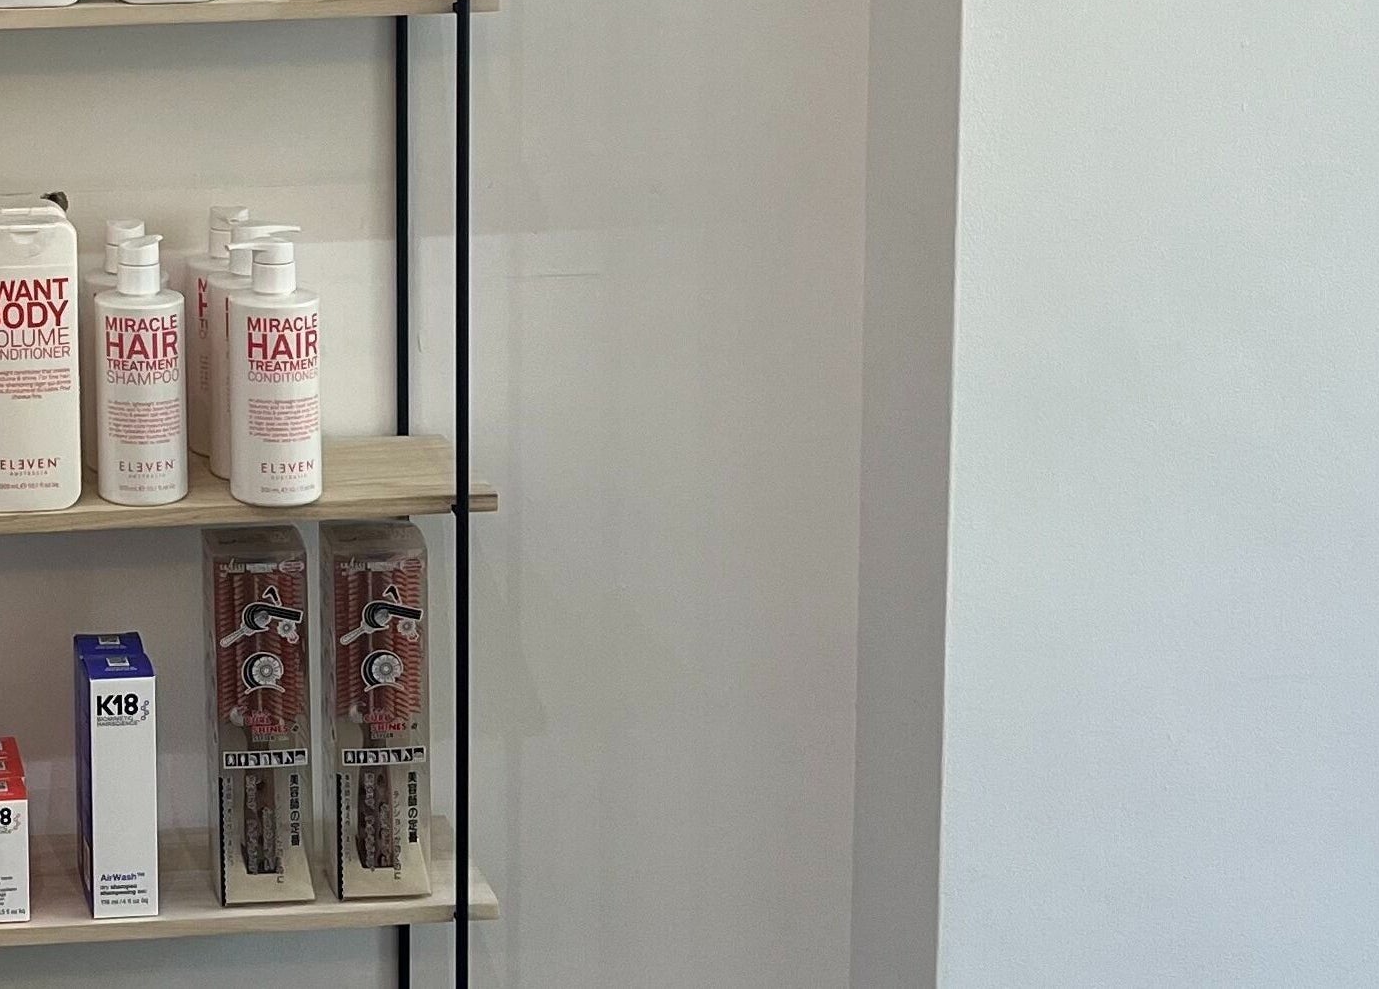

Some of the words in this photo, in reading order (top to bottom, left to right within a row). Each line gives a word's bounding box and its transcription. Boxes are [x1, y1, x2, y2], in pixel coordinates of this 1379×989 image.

[105, 314, 177, 332] MIRACLE
[247, 313, 318, 333] MIRACLE
[105, 331, 178, 360] HAIR
[247, 330, 318, 360] HAIR
[107, 357, 178, 371] TREATMENT
[249, 358, 318, 372] TREATMENT
[106, 369, 180, 385] SHAMPOO
[248, 368, 318, 384] CONDITIONER
[97, 693, 138, 716] K18
